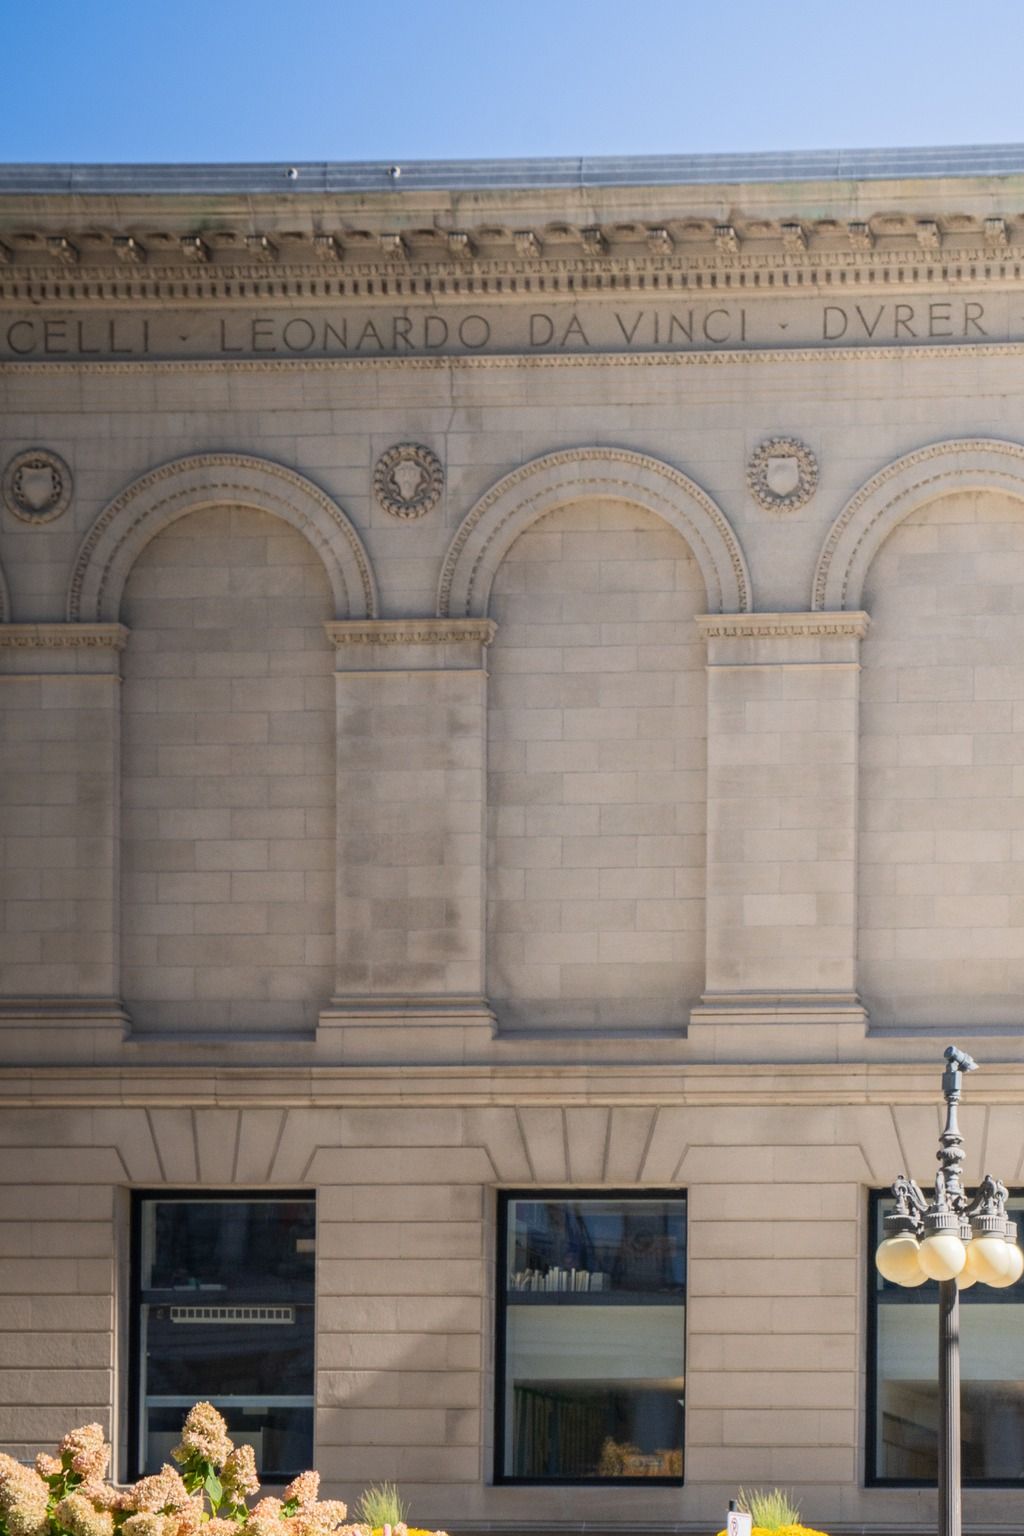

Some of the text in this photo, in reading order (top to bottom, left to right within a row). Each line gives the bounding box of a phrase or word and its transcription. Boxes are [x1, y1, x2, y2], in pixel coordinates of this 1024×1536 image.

[6, 319, 150, 355] CELLI
[219, 314, 491, 353] LEONARDO
[529, 312, 590, 347] DA
[614, 308, 747, 345] VINCI
[822, 301, 988, 340] DVRER
